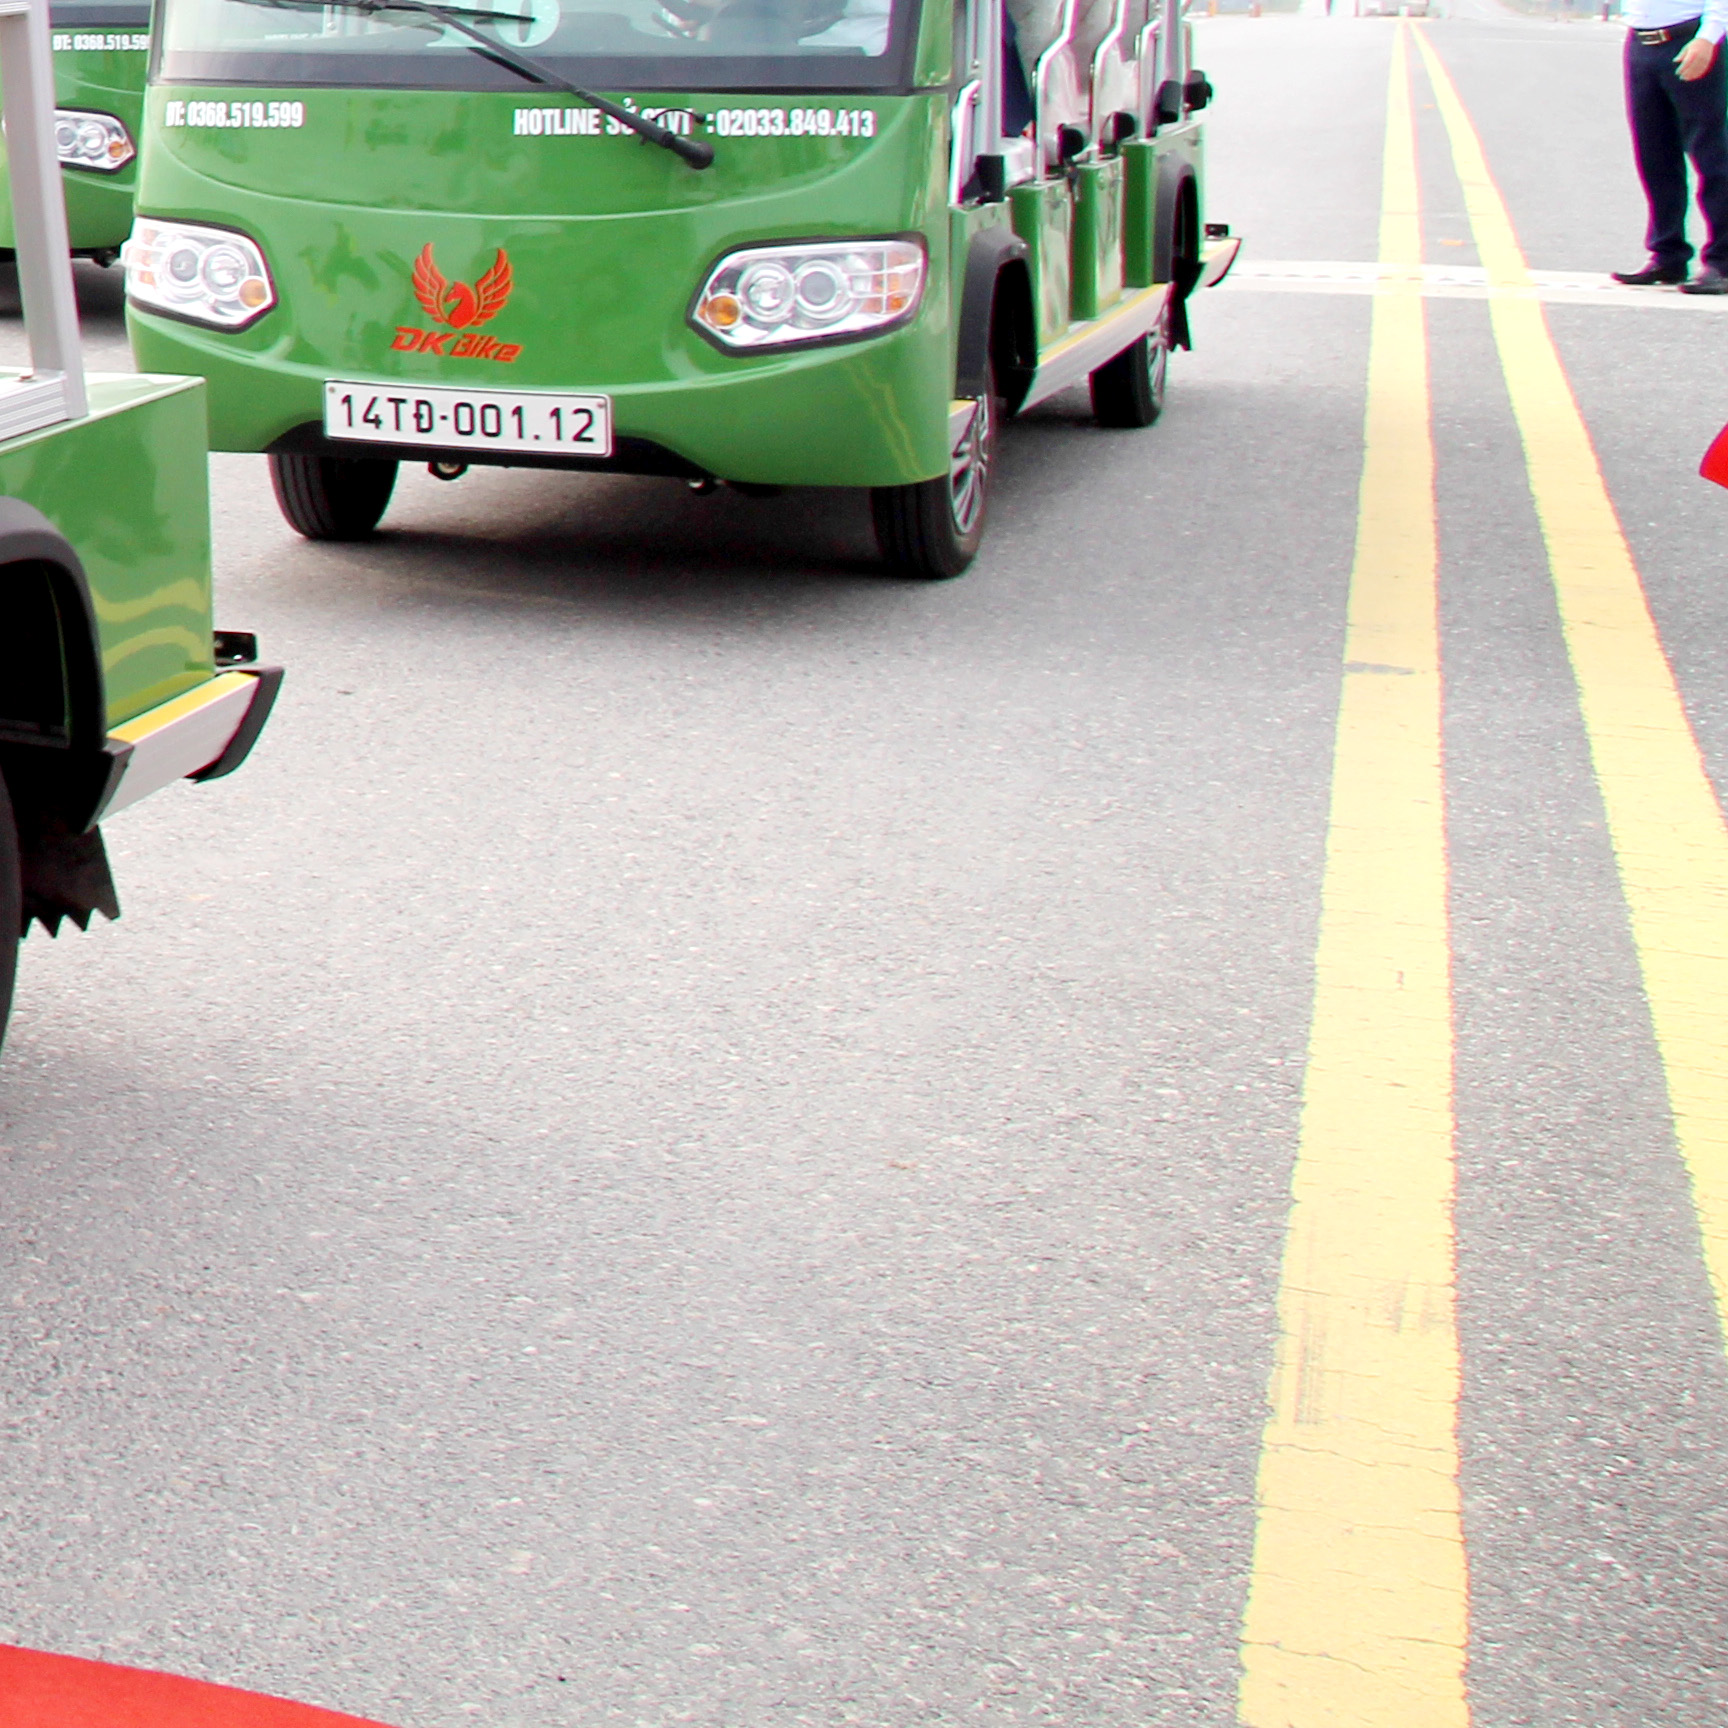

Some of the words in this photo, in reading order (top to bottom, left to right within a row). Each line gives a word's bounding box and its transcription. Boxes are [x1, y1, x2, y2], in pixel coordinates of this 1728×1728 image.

[187, 101, 306, 128] 0368.519.599
[513, 108, 602, 135] HOTLINE
[390, 325, 456, 357] DK
[449, 332, 525, 363] Bike
[341, 393, 596, 444] 14TĐ-001.12
